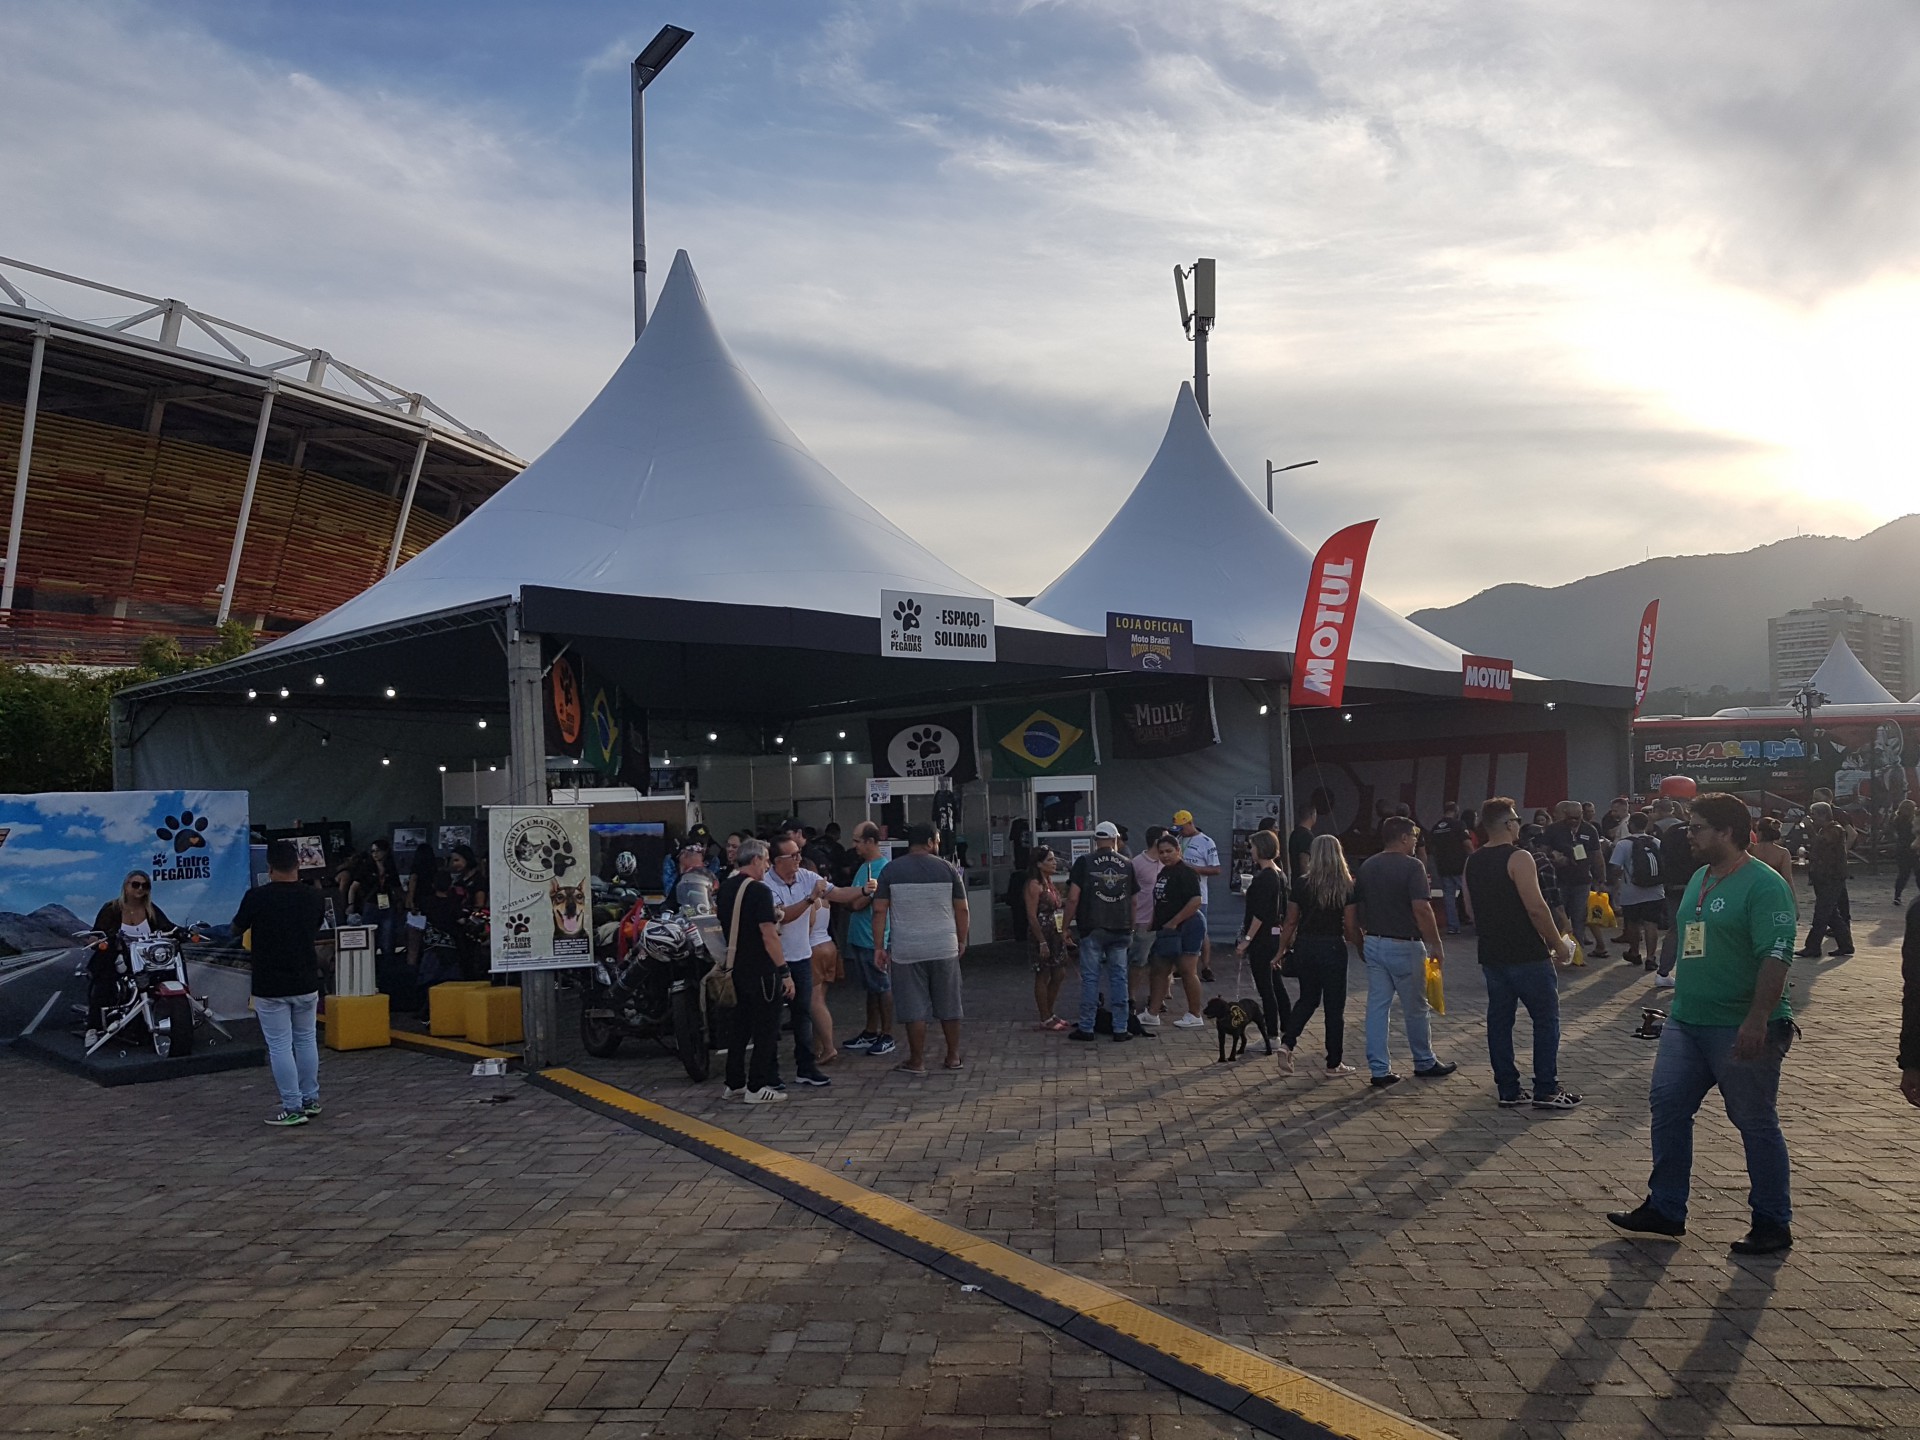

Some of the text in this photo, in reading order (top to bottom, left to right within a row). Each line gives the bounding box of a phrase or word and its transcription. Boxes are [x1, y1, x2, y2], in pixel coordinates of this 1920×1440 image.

[942, 609, 980, 630] ESPAÇO
[1115, 616, 1185, 634] LOJA OFICIAL
[1303, 557, 1354, 697] MOTUL
[903, 632, 922, 643] Entre
[934, 630, 988, 649] SOLIDARIO
[1130, 633, 1149, 644] Moto
[890, 641, 922, 652] PEGADAS
[1464, 665, 1512, 691] MOTUL
[1135, 702, 1185, 726] MOLLY
[921, 759, 945, 769] Entre
[906, 767, 946, 777] PEGADAS
[176, 855, 210, 867] Entre
[153, 867, 211, 881] PEGADAS
[503, 941, 532, 950] PEGADAS
